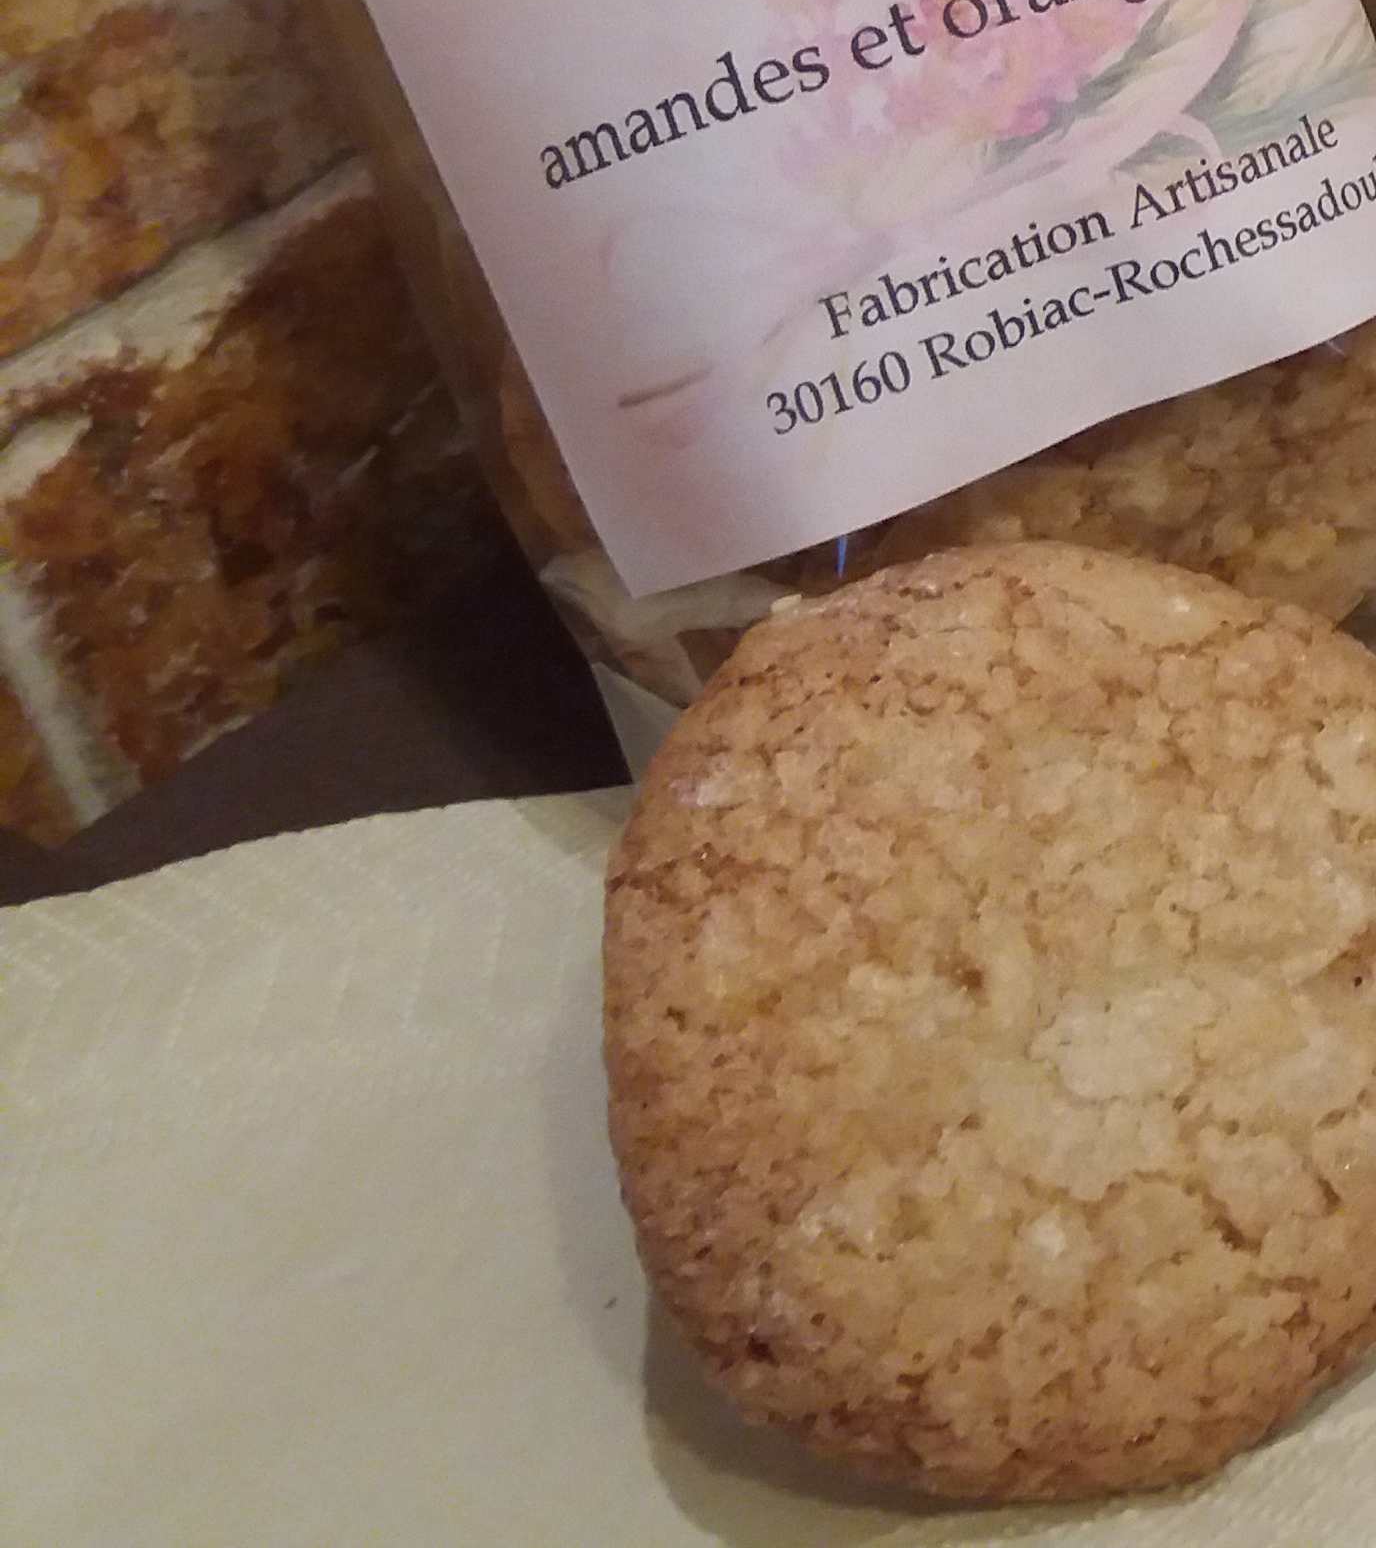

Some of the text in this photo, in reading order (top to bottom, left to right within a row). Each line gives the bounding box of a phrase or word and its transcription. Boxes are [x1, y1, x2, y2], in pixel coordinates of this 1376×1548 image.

[541, 47, 829, 189] amandes
[851, 4, 925, 69] et
[819, 115, 1339, 339] Fabrication Artisanale
[767, 352, 910, 434] 30160
